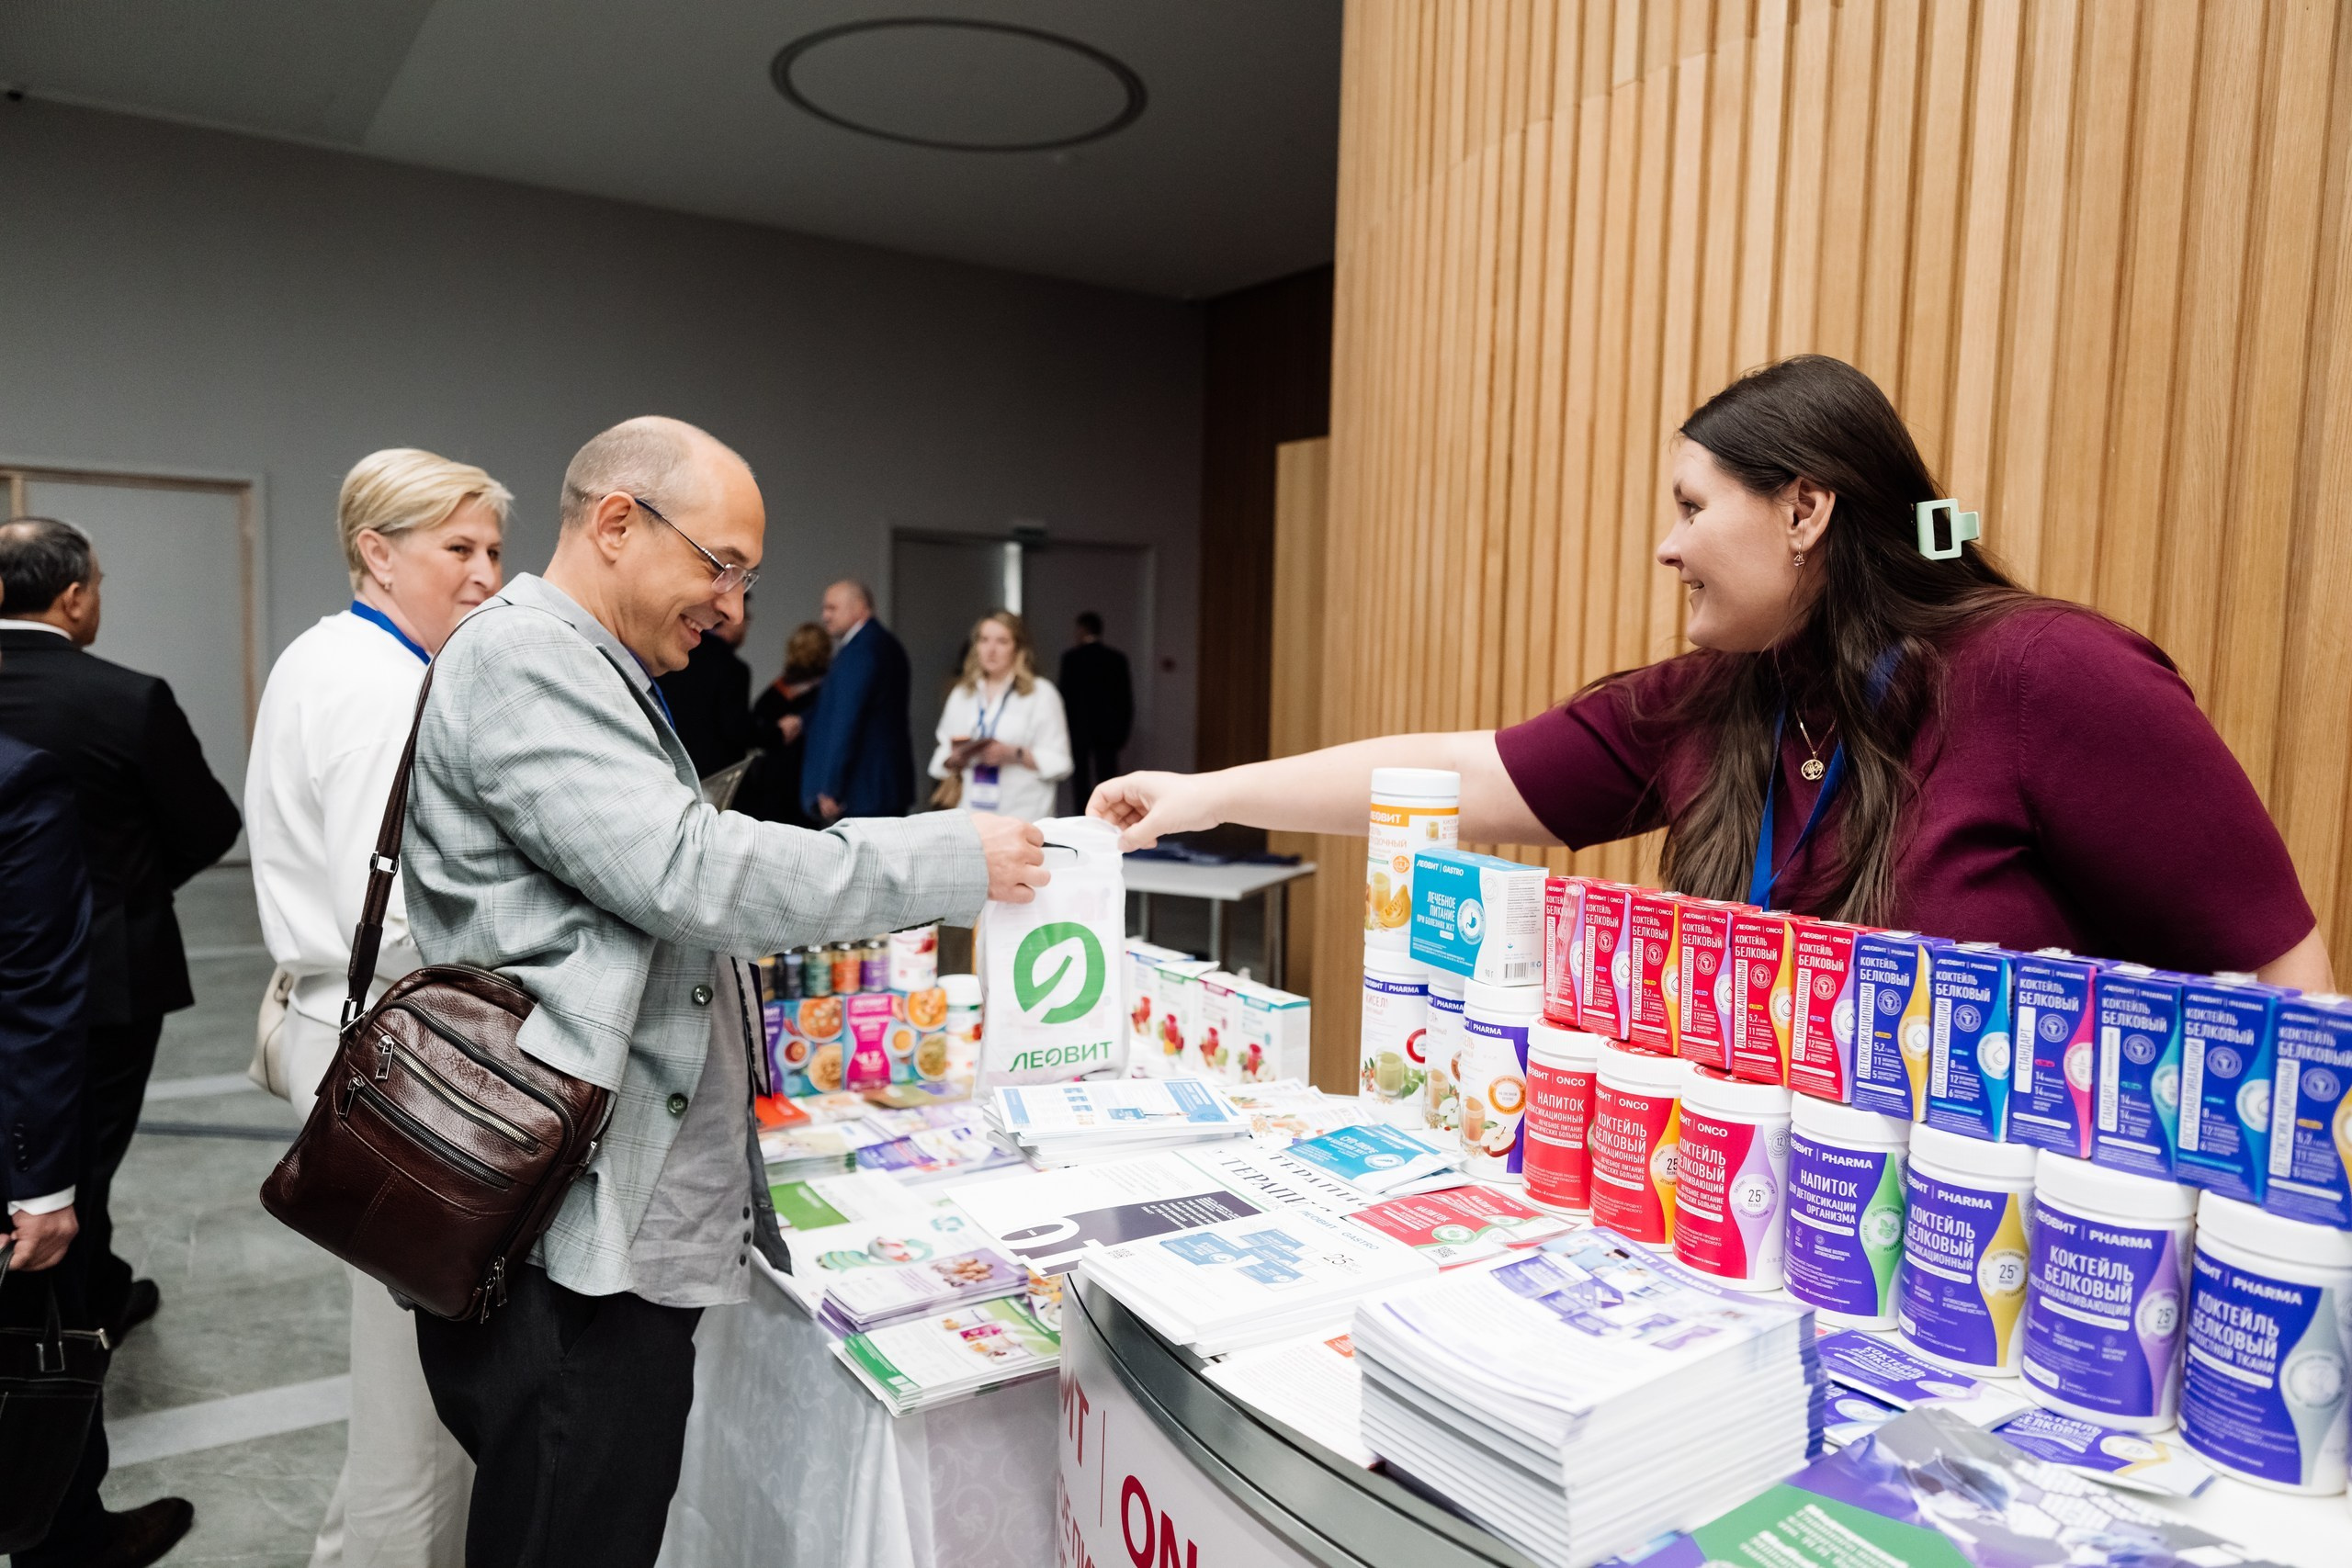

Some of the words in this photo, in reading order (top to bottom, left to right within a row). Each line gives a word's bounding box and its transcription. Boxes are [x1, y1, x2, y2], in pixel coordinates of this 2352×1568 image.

[1417, 859, 1439, 871] ЛЕОВИТ
[1442, 865, 1464, 876] GASTRO
[1427, 891, 1456, 909] ЛЕЧЕБНОЕ
[1587, 894, 1607, 902] ЛЕОВИТ
[1430, 905, 1455, 922] ПИТАНИЕ
[1586, 904, 1611, 915] КОКТЕЙЛЬ
[1633, 906, 1655, 914] ЛЕОВИТ
[1682, 912, 1706, 921] ЛЕОВИТ
[1586, 914, 1619, 928] БЕЛКОВЫЙ
[1632, 915, 1660, 927] КОКТЕЙЛЬ
[1682, 922, 1713, 935] КОКТЕЙЛЬ
[1736, 923, 1761, 931] ЛЕОВИТ
[1633, 925, 1668, 941] БЕЛКОВЫЙ
[1735, 934, 1767, 946] КОКТЕЙЛЬ
[1800, 931, 1828, 941] ЛЕОВИТ
[1833, 937, 1851, 945] ONCO
[1682, 934, 1722, 949] БЕЛКОВЫЙ
[1799, 942, 1834, 956] КОКТЕЙЛЬ
[1735, 946, 1778, 961] БЕЛКОВЫЙ
[1860, 944, 1887, 954] ЛЕОВИТ
[1891, 949, 1915, 958] PHARMA
[1585, 927, 1595, 1005] ВОССТАНАВЛИВАЮЩИЙ
[1798, 954, 1845, 973] БЕЛКОВЫЙ
[1860, 956, 1898, 971] КОКТЕЙЛЬ
[1633, 940, 1643, 1020] ДЕТОКСИКАЦИОННЫЙ
[1860, 968, 1909, 987] БЕЛКОВЫЙ
[1936, 970, 1978, 985] КОКТЕЙЛЬ
[1388, 986, 1419, 994] PHARMA
[1594, 987, 1600, 995] 12
[1644, 989, 1652, 998] 5,2
[1682, 948, 1693, 1031] ВОССТАНАВЛИВАЮЩИЙ
[1935, 983, 1990, 1002] БЕЛКОВЫЙ
[2019, 978, 2064, 994] КОКТЕЙЛЬ
[1644, 1000, 1649, 1009] 11
[1736, 961, 1747, 1048] ДЕТОКСИКАЦИОННЫЙ
[2018, 993, 2078, 1011] БЕЛКОВЫЙ
[2101, 998, 2151, 1014] КОКТЕЙЛЬ
[1643, 1012, 1646, 1021] 5
[1693, 1011, 1700, 1020] 12
[1748, 1014, 1758, 1023] 5,2
[1794, 970, 1811, 1060] ВОССТАНАВЛИВАЮЩИЙ
[2101, 1010, 2166, 1032] БЕЛКОВЫЙ
[2185, 1008, 2238, 1026] КОКТЕЙЛЬ
[1473, 1024, 1502, 1035] PHARMA
[1748, 1027, 1755, 1035] 11
[1808, 1025, 1813, 1033] 8
[1859, 985, 1873, 1078] ДЕТОКСИКАЦИОННЫЙ
[2184, 1021, 2254, 1045] БЕЛКОВЫЙ
[1747, 1040, 1752, 1048] 5
[1807, 1039, 1815, 1048] 12
[1874, 1043, 1884, 1052] 5,2
[1933, 1000, 1950, 1097] ВОССТАНАВЛИВАЮЩИЙ
[2018, 1028, 2033, 1072] СТАНДАРТ
[1009, 1041, 1114, 1073] ЛЕОВИТ
[1806, 1053, 1811, 1061] 6
[1873, 1056, 1882, 1065] 11
[1951, 1059, 1956, 1068] 8
[1556, 1077, 1586, 1087] ONCO
[1872, 1070, 1878, 1078] 5
[1950, 1074, 1958, 1084] 12
[1537, 1091, 1585, 1112] НАПИТОК
[1949, 1089, 1954, 1098] 6
[1618, 1099, 1649, 1111] ONCO
[2102, 1084, 2115, 1127] СТАНДАРТ
[1538, 1119, 1559, 1130] ЛЕЧЕБНОЕ
[1560, 1123, 1583, 1133] ПИТАНИЕ
[1598, 1111, 1647, 1138] КОКТЕЙЛЬ
[1697, 1122, 1728, 1138] ONCO
[1558, 1131, 1583, 1140] БОЛЬНЫХ
[1595, 1125, 1646, 1154] БЕЛКОВЫЙ
[1776, 1137, 1783, 1146] 12
[1600, 1156, 1620, 1169] ЛЕЧЕБНОЕ
[1621, 1162, 1645, 1174] ПИТАНИЕ
[1667, 1158, 1679, 1171] 25
[1821, 1152, 1873, 1169] PHARMA
[1619, 1170, 1645, 1181] БОЛЬНЫХ
[1801, 1169, 1858, 1199] НАПИТОК
[1680, 1184, 1699, 1199] ЛЕЧЕБНОЕ
[1700, 1193, 1724, 1204] ПИТАНИЕ
[1747, 1190, 1761, 1203] 25
[1796, 1187, 1856, 1213] ДЕТОКСИКАЦИИ
[1937, 1191, 1993, 1210] PHARMA
[1697, 1200, 1723, 1212] БОЛЬНЫХ
[1413, 1205, 1453, 1224] НАПИТОК
[1806, 1204, 1856, 1225] ОРГАНИЗМА
[1911, 1203, 1975, 1239] КОКТЕЙЛЬ
[1296, 1210, 1340, 1230] ЛЕОВИТ
[1340, 1232, 1379, 1250] GASTRO
[1908, 1221, 1974, 1259] БЕЛКОВЫЙ
[2089, 1229, 2153, 1250] PHARMA
[1323, 1253, 1354, 1266] 25
[1598, 1231, 1658, 1265] ЛЕОВИТ
[1664, 1268, 1723, 1295] PHARMA
[2050, 1245, 2134, 1283] КОКТЕЙЛЬ
[1999, 1264, 2015, 1280] 25
[2044, 1263, 2132, 1303] БЕЛКОВЫЙ
[2233, 1277, 2302, 1305] PHARMA
[2197, 1289, 2279, 1339] КОКТЕЙЛЬ
[2193, 1308, 2278, 1360] БЕЛКОВЫЙ
[2236, 1352, 2276, 1375] ТКАНИ
